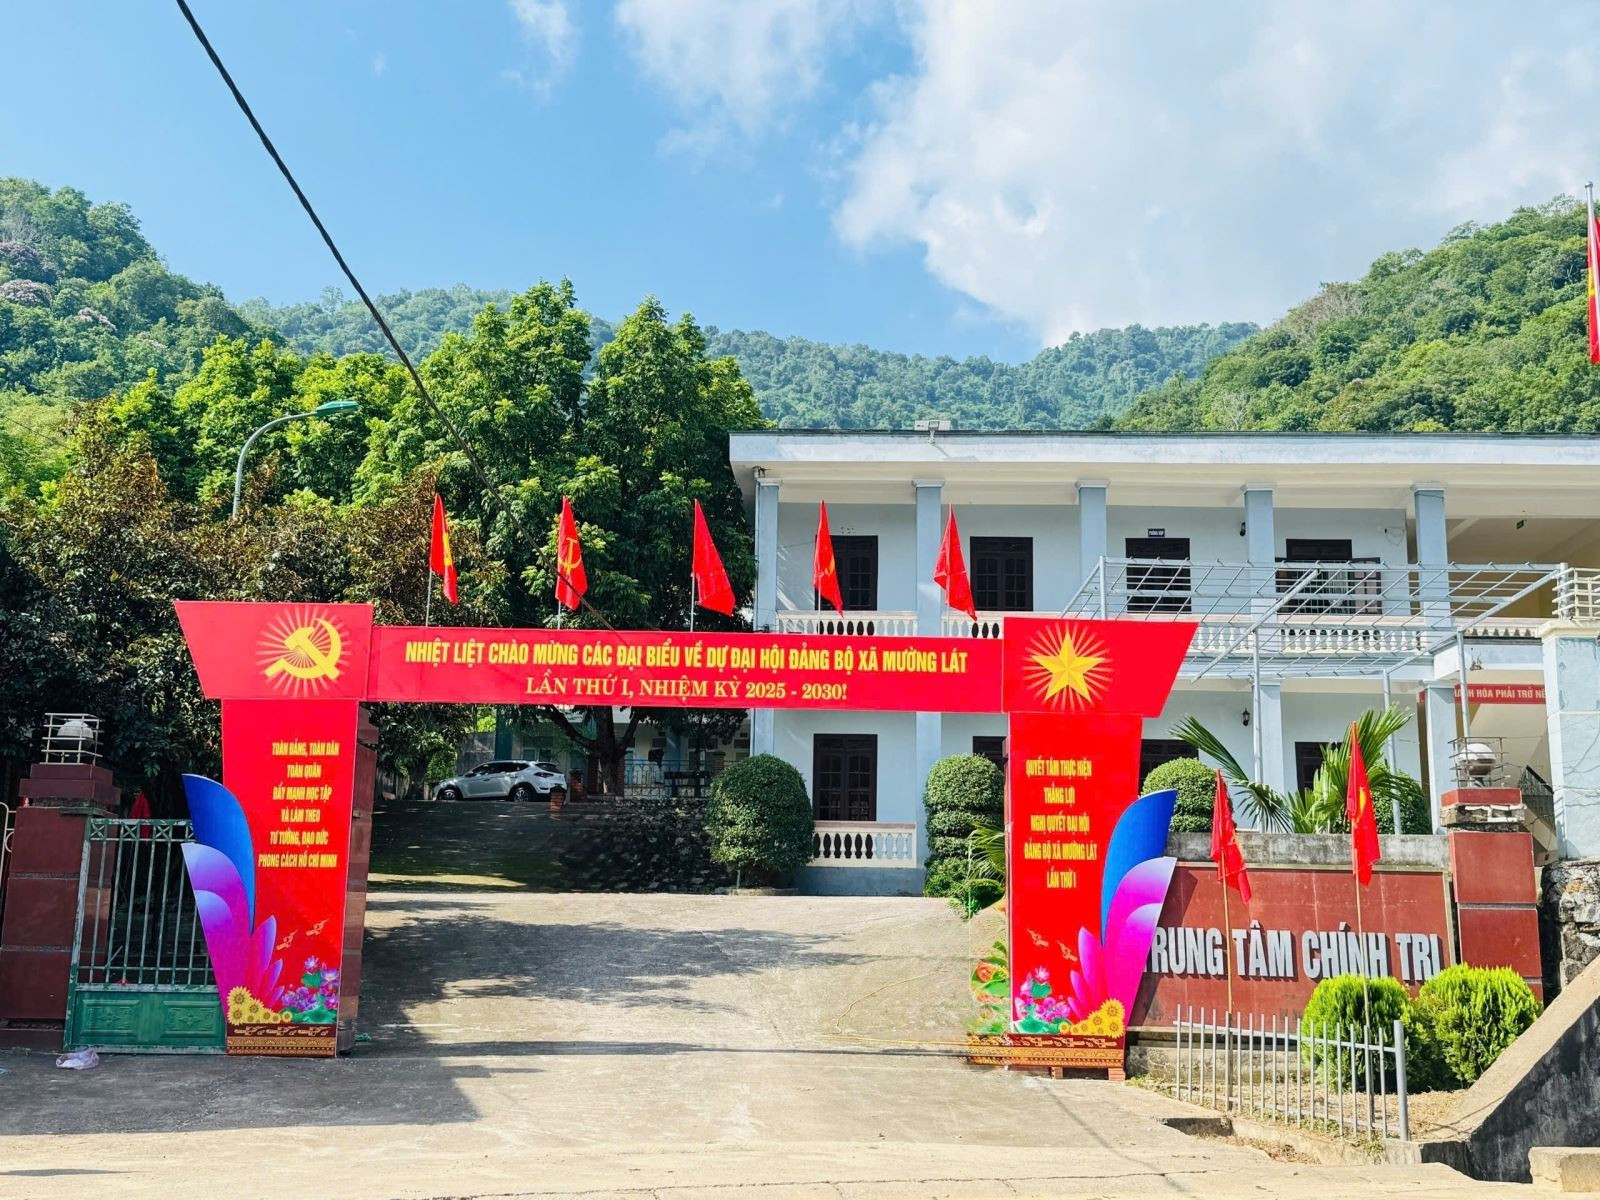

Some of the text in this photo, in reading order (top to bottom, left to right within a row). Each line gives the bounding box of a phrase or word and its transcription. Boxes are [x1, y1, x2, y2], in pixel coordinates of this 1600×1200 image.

[404, 637, 968, 676] NHIỆT LIỆT CHÀO MỪNG CÁC ĐẠI BIỂU VỀ DỰ ĐẠI HỘI ĐẢNG BỘ XÃ MƯỜNG LÁT
[526, 669, 568, 695] LẦN
[573, 674, 619, 696] THỨ
[622, 679, 634, 699] I,
[639, 675, 708, 703] NHIỆM
[714, 676, 741, 698] KỲ
[745, 682, 787, 699] 2025
[802, 684, 847, 700] 2030!
[1535, 688, 1546, 699] NÊ
[1026, 755, 1045, 778] QUYẾT
[1046, 757, 1059, 777] TÂM
[1060, 759, 1077, 780] THỰC
[305, 808, 321, 823] THEO
[258, 853, 280, 868] PHONG
[1024, 838, 1042, 860] ĐẢNG
[1052, 841, 1061, 860] XÃ
[1086, 841, 1098, 861] LÁT
[1143, 926, 1224, 977] RUNG
[1231, 919, 1294, 978] TÂM
[1301, 922, 1388, 979] CHÍNH
